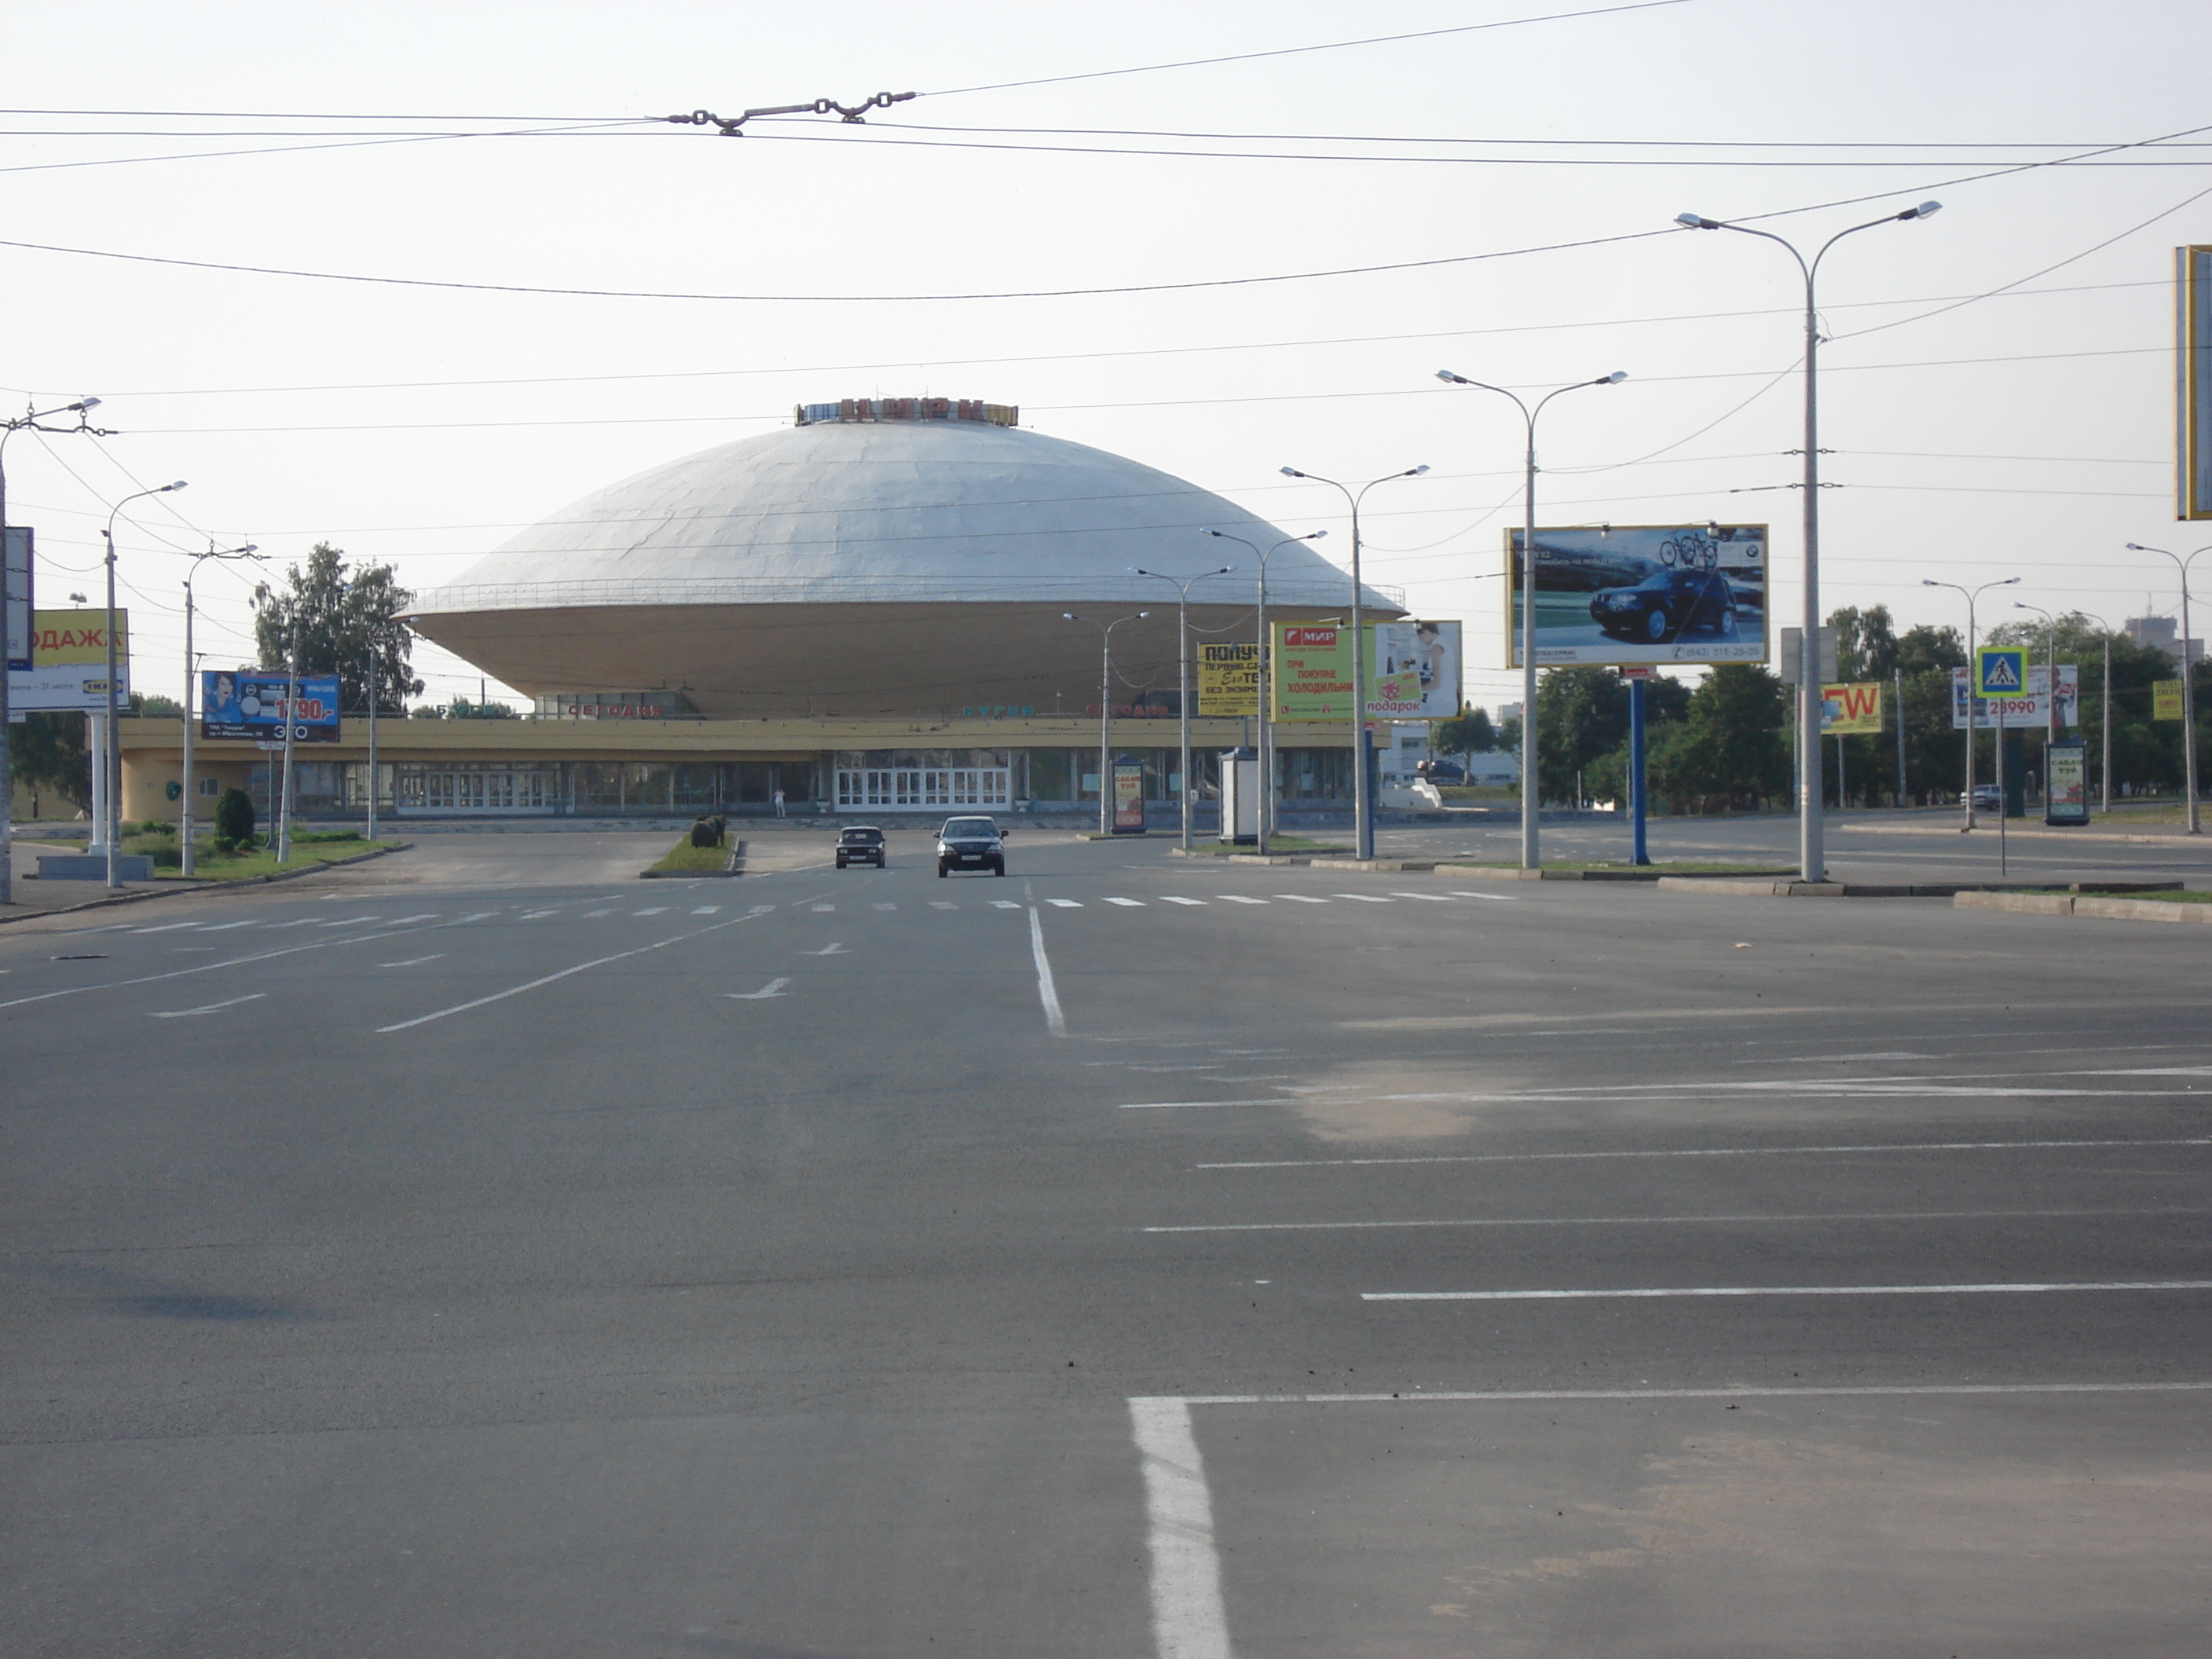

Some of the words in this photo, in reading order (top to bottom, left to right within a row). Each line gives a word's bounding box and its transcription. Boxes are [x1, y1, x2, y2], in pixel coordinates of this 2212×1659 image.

[840, 397, 985, 423] ЦИРК
[1304, 632, 1335, 641] МИР
[1205, 646, 1270, 661] ПОЛУЧ
[1287, 660, 1304, 668] ПРИ
[1298, 670, 1336, 679] ПОКУПКЕ
[1287, 682, 1365, 694] ХОЛОДИЛЬНИ
[1367, 700, 1420, 713] подарок
[1814, 688, 1877, 720] EW
[566, 705, 663, 716] СЕГОДНЯ
[274, 725, 307, 739] ЭО
